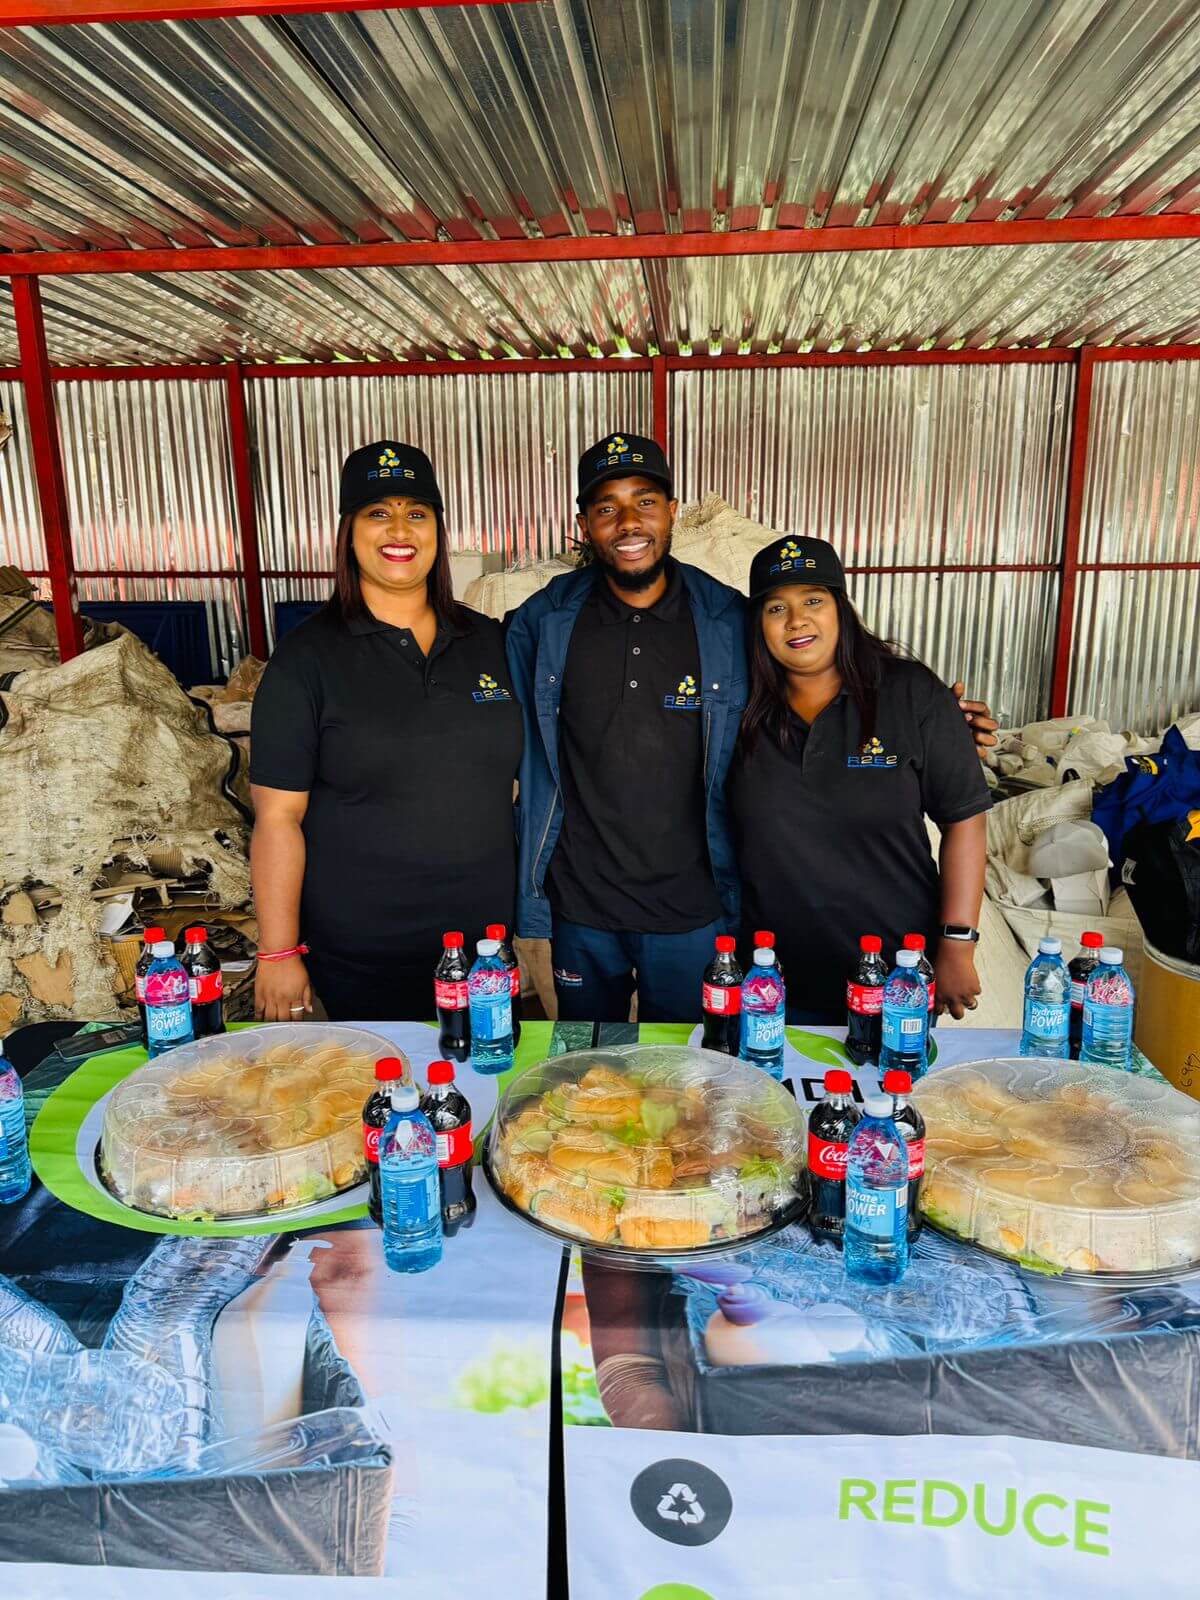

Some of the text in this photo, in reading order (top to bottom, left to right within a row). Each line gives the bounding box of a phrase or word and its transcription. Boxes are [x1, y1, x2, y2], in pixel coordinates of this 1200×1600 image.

[597, 453, 644, 470] R2E2
[367, 468, 416, 480] R2E2
[769, 558, 817, 575] R2E2
[472, 688, 512, 701] R2E2
[847, 755, 898, 765] R2E2
[848, 1197, 887, 1217] OWER
[837, 1477, 1111, 1557] REDUCE
